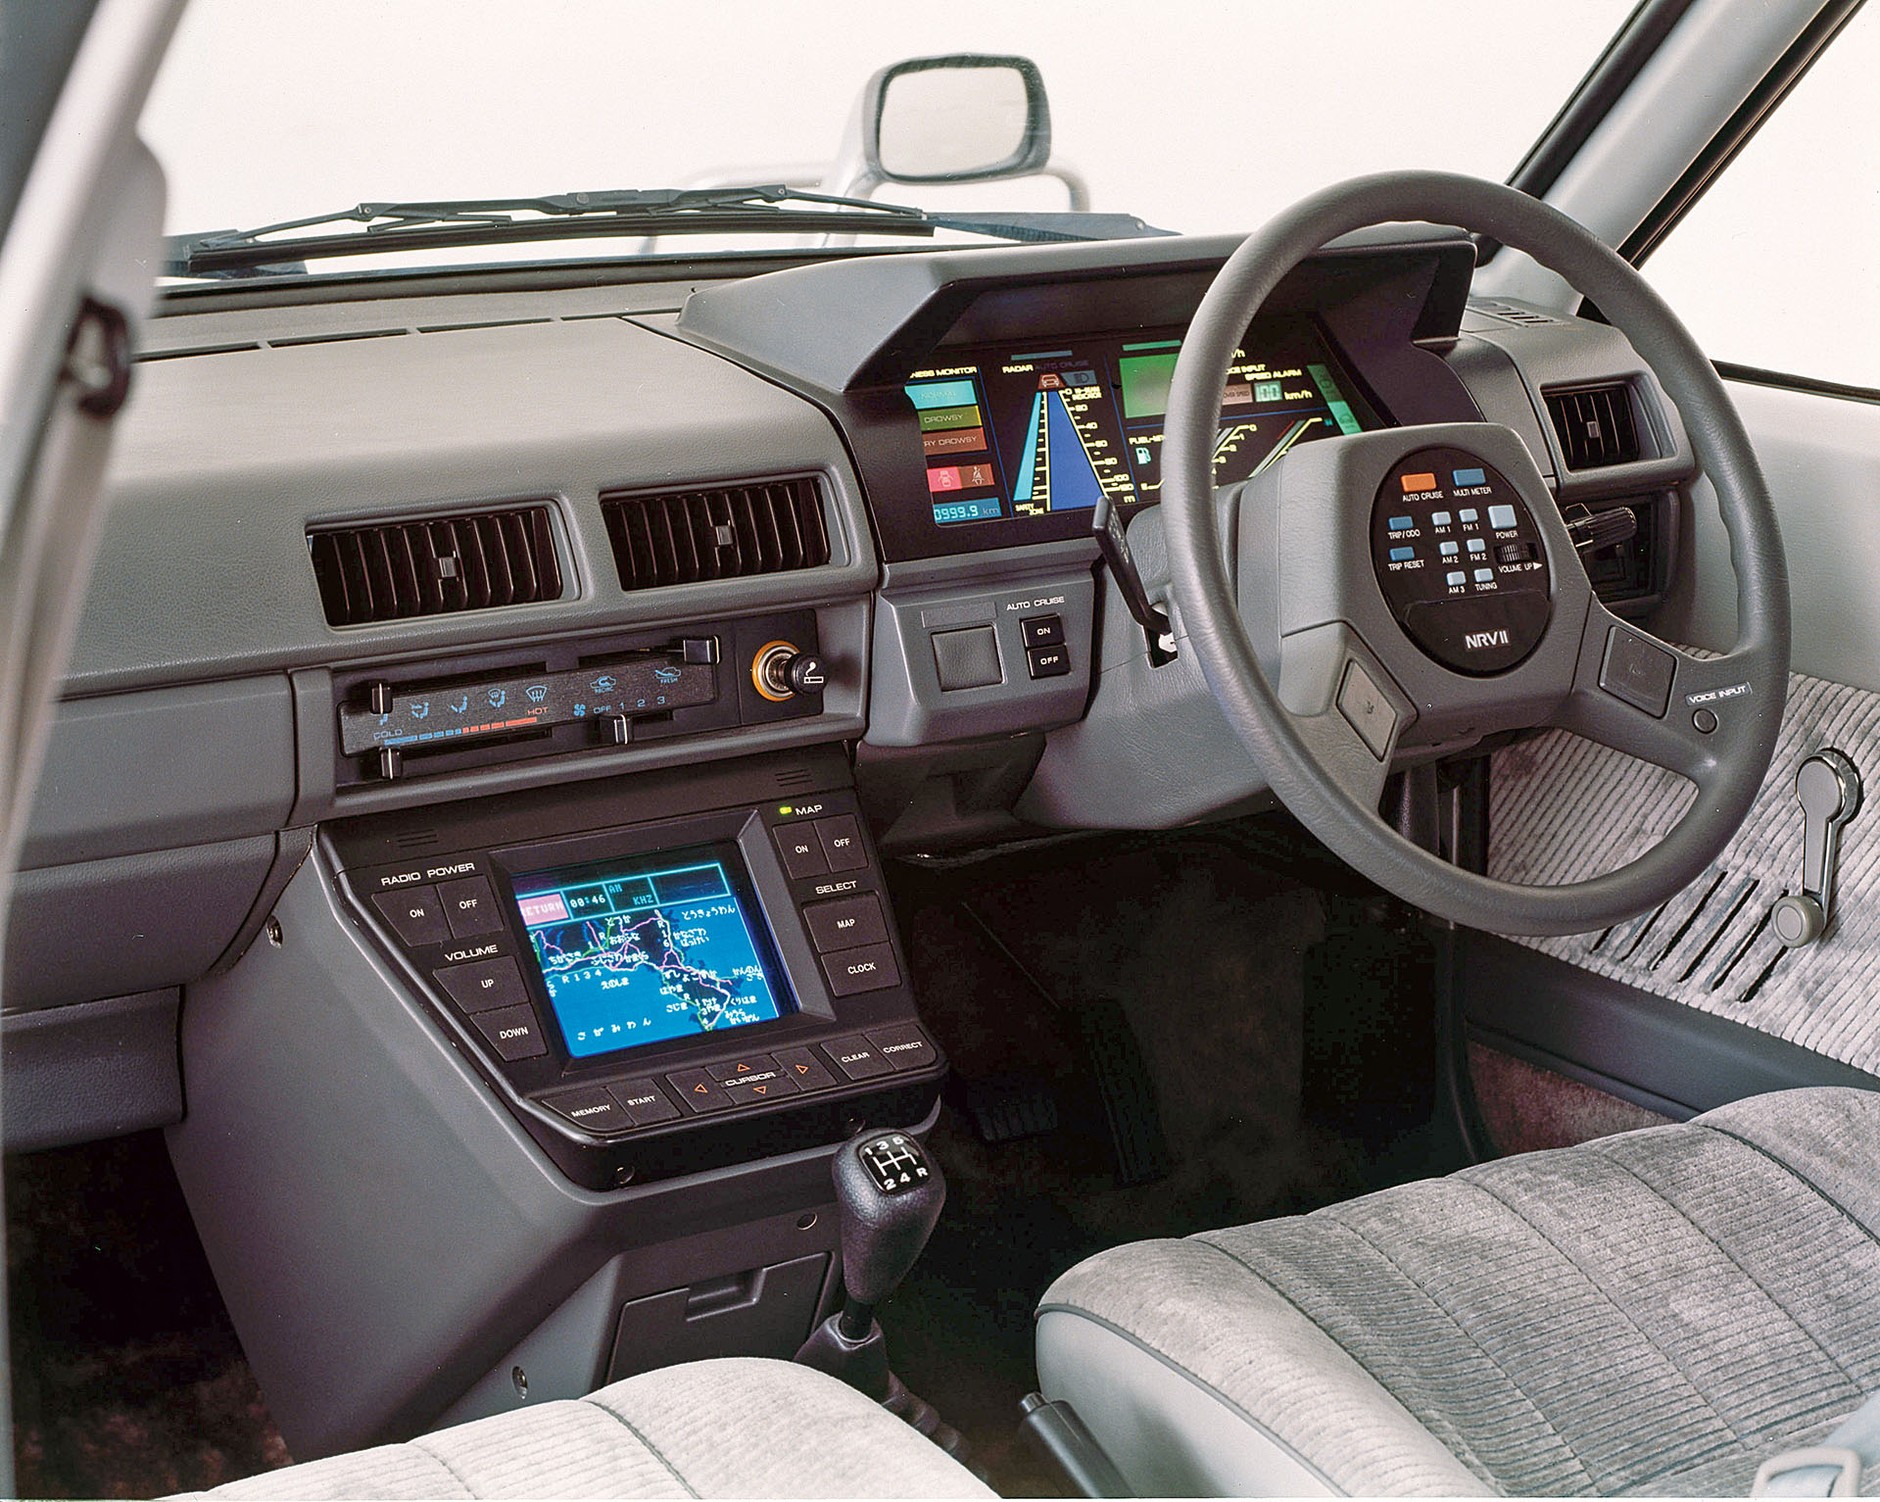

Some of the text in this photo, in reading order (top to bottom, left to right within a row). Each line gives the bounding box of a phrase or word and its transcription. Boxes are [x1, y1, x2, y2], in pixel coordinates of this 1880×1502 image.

[936, 366, 978, 376] MONITOR
[1002, 364, 1034, 374] RADAR
[1273, 369, 1302, 379] ALARM
[1284, 390, 1313, 400] km/h
[924, 414, 963, 424] DROWSY
[939, 436, 977, 446] DROWSY
[1402, 491, 1443, 502] AUTO CRUISE
[1453, 487, 1492, 497] MULTI METER
[983, 506, 1000, 516] km
[1435, 526, 1445, 534] AM
[1463, 524, 1474, 532] FM
[1496, 530, 1518, 539] POWER
[1442, 556, 1452, 564] AM
[1470, 553, 1480, 561] FM
[1388, 560, 1425, 571] TRIP RESET
[1498, 562, 1533, 573] VOLUME UP
[1449, 586, 1459, 594] AM
[1475, 582, 1498, 591] TUNING
[1007, 596, 1065, 611] AUTO CRUISE
[1037, 627, 1051, 636] ON
[1040, 656, 1059, 665] OFF
[1689, 685, 1746, 704] VOICE INPUT
[593, 705, 612, 714] OFF
[637, 699, 646, 707] 2
[657, 696, 665, 705] 3
[527, 706, 549, 716] HOT
[373, 728, 403, 741] COLD
[795, 804, 823, 816] MAP
[834, 838, 850, 848] OFF
[795, 845, 809, 854] ON
[381, 862, 475, 886] RADIO POWER
[815, 880, 858, 895] SELECT
[459, 899, 478, 910] OFF
[633, 894, 654, 905] KHZ
[409, 908, 425, 919] ON
[837, 919, 856, 929] MAP
[445, 944, 499, 962] VOLUME
[847, 962, 876, 975] CLOCK
[481, 979, 494, 989] UP
[499, 1026, 529, 1040] DOWN
[883, 1041, 923, 1054] CORRECT
[841, 1052, 870, 1063] CLEAR
[725, 1071, 776, 1087] CURSOR
[627, 1095, 656, 1106] START
[571, 1104, 612, 1118] MEMORY
[864, 1135, 905, 1156] 1 3 5
[884, 1167, 929, 1191] 2 4 R
